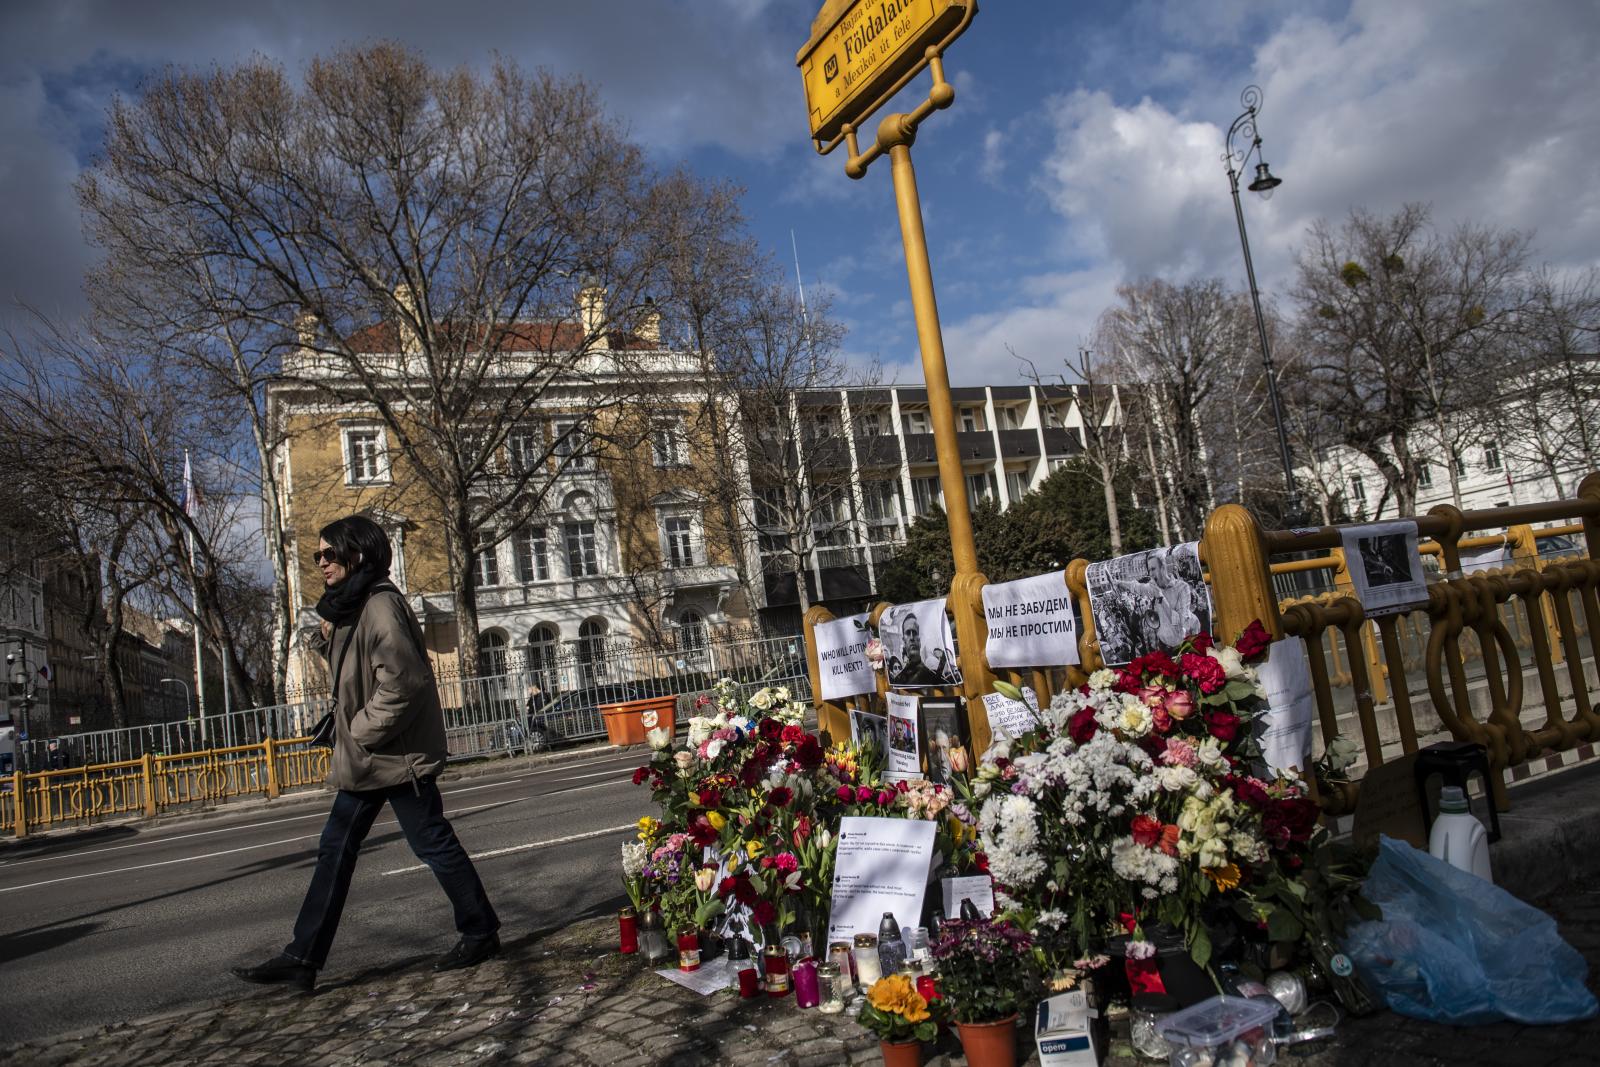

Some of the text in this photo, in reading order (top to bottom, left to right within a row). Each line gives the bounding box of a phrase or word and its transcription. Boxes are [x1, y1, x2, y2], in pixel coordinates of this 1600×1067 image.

[839, 8, 864, 35] Bajza
[844, 0, 914, 64] Földalat
[835, 15, 912, 98] a Mexikói út felé
[988, 597, 1069, 620] МЫ НЕ ЗАБУДЕМ
[989, 619, 1073, 640] МЫ НЕ ПРОСТИМ
[821, 648, 836, 661] WHO
[835, 645, 849, 658] WILL
[831, 660, 864, 676] KILL NEXT?
